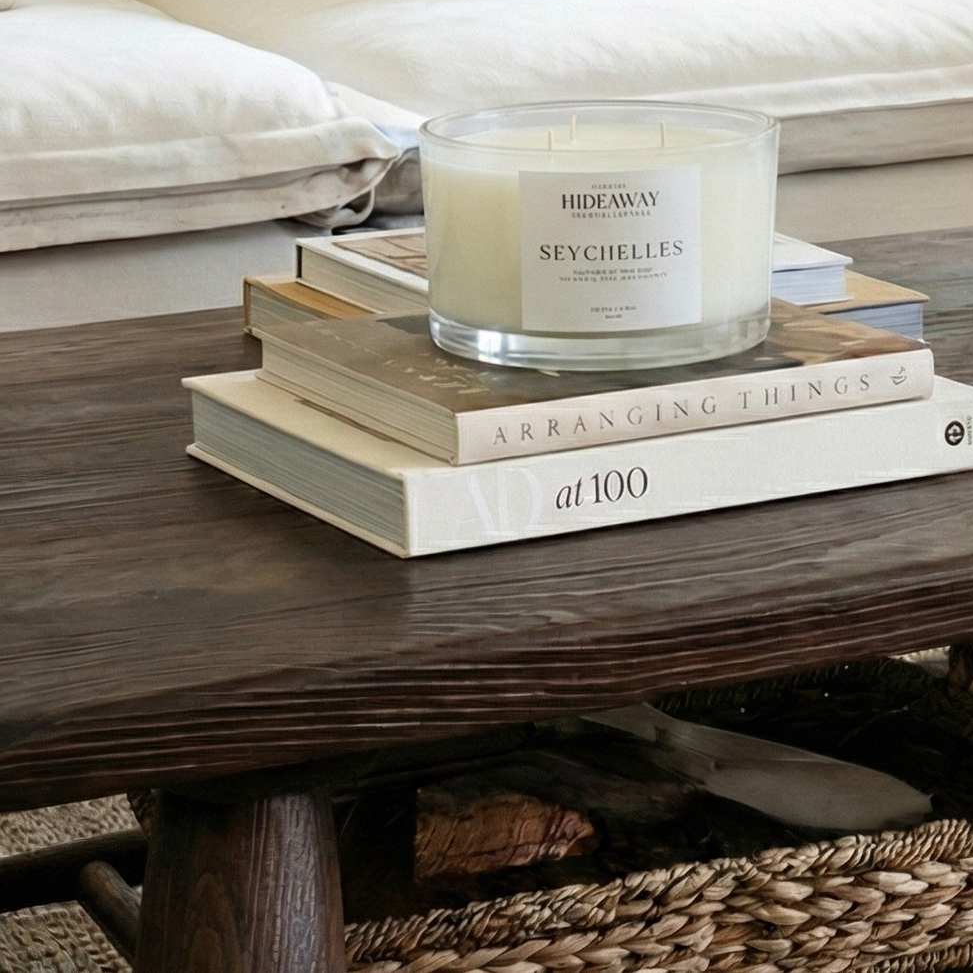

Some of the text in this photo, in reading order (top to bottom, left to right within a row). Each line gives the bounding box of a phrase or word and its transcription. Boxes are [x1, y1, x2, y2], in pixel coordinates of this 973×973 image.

[562, 190, 660, 209] HIDEAWAY
[539, 240, 684, 262] SEYCHELLES
[493, 374, 870, 445] ARRANGING THINGS
[555, 477, 584, 509] at
[590, 466, 648, 503] 100
